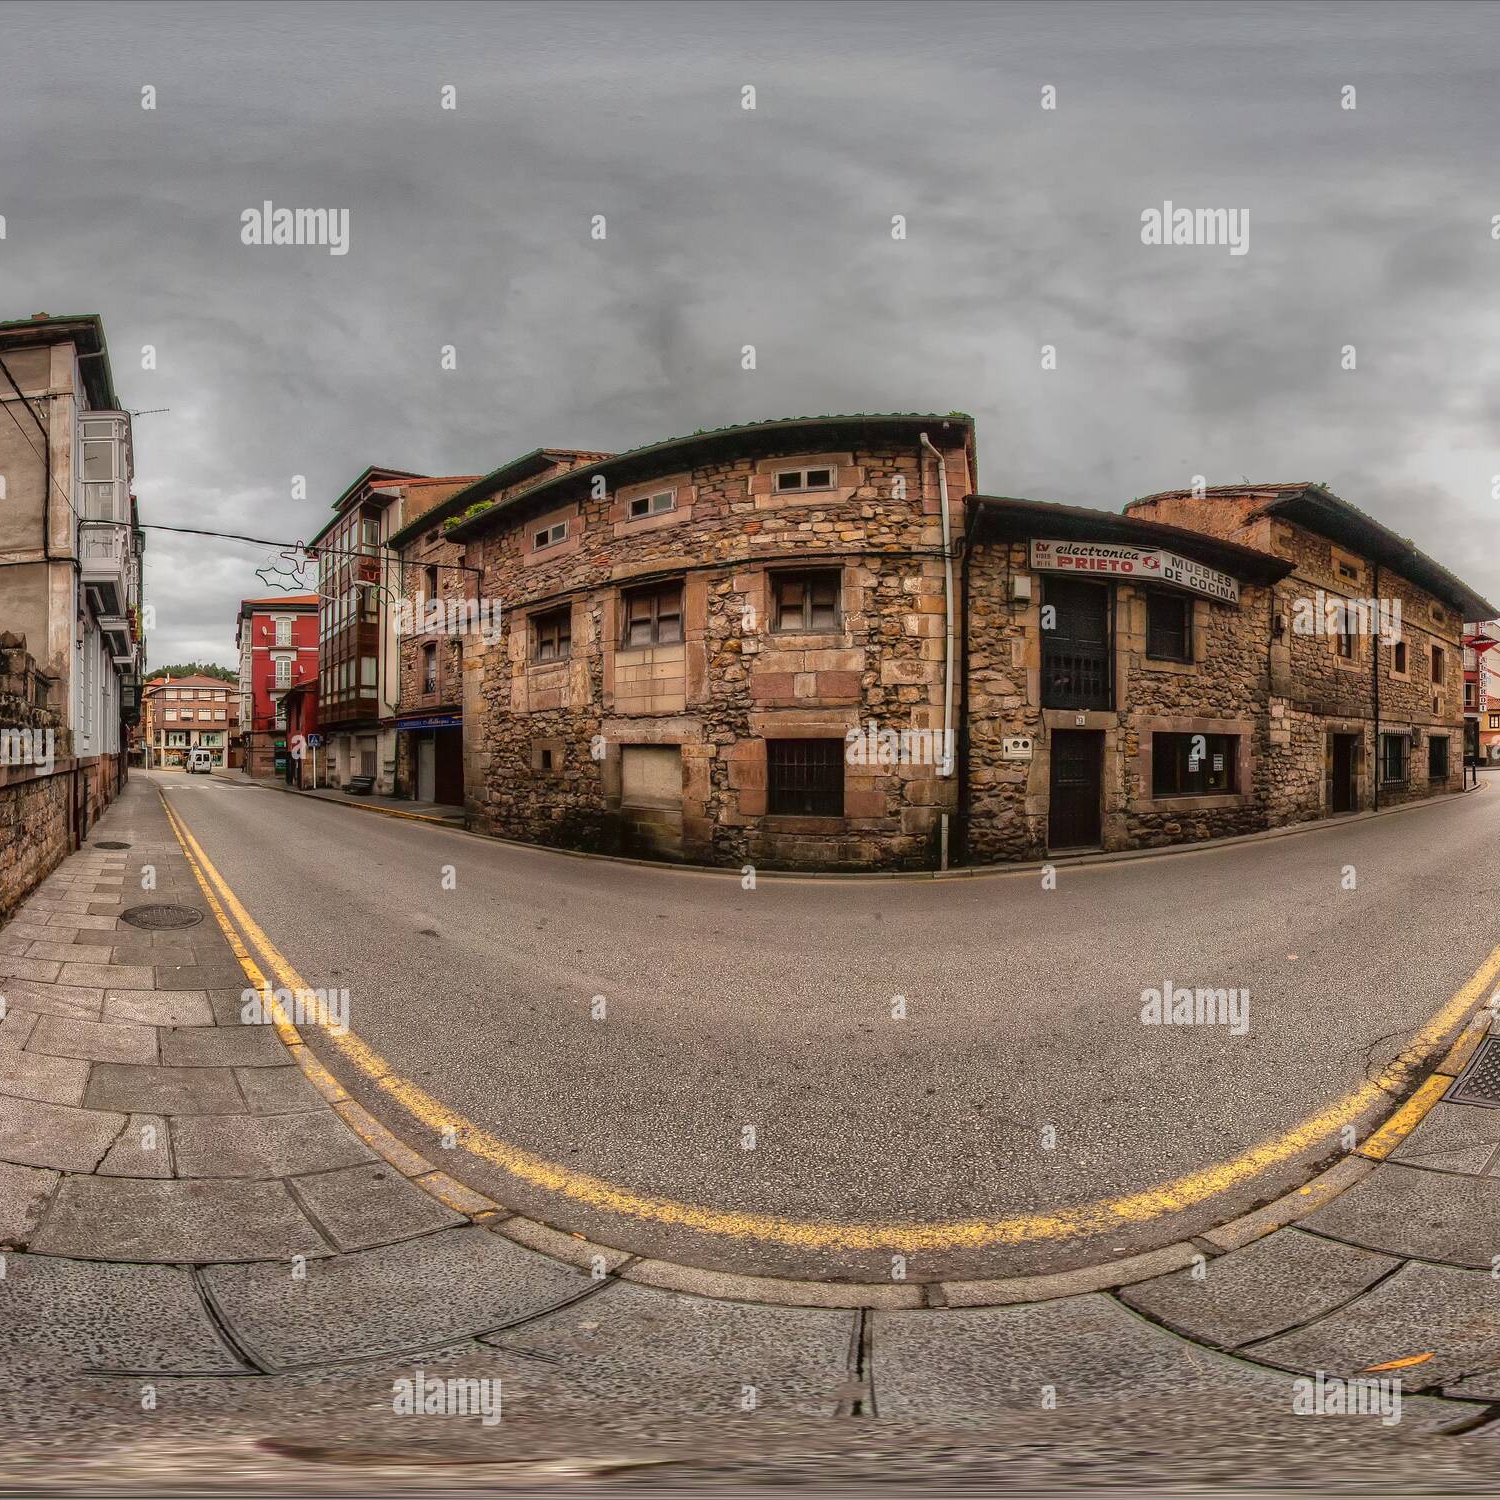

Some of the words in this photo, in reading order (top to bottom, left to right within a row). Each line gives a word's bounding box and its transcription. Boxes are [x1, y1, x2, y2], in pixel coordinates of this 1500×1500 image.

[1035, 542, 1050, 551] tv
[1057, 556, 1134, 572] PRIETO
[1171, 557, 1232, 587] MUEBLES
[1164, 567, 1182, 582] DE
[1190, 576, 1237, 601] COCINA
